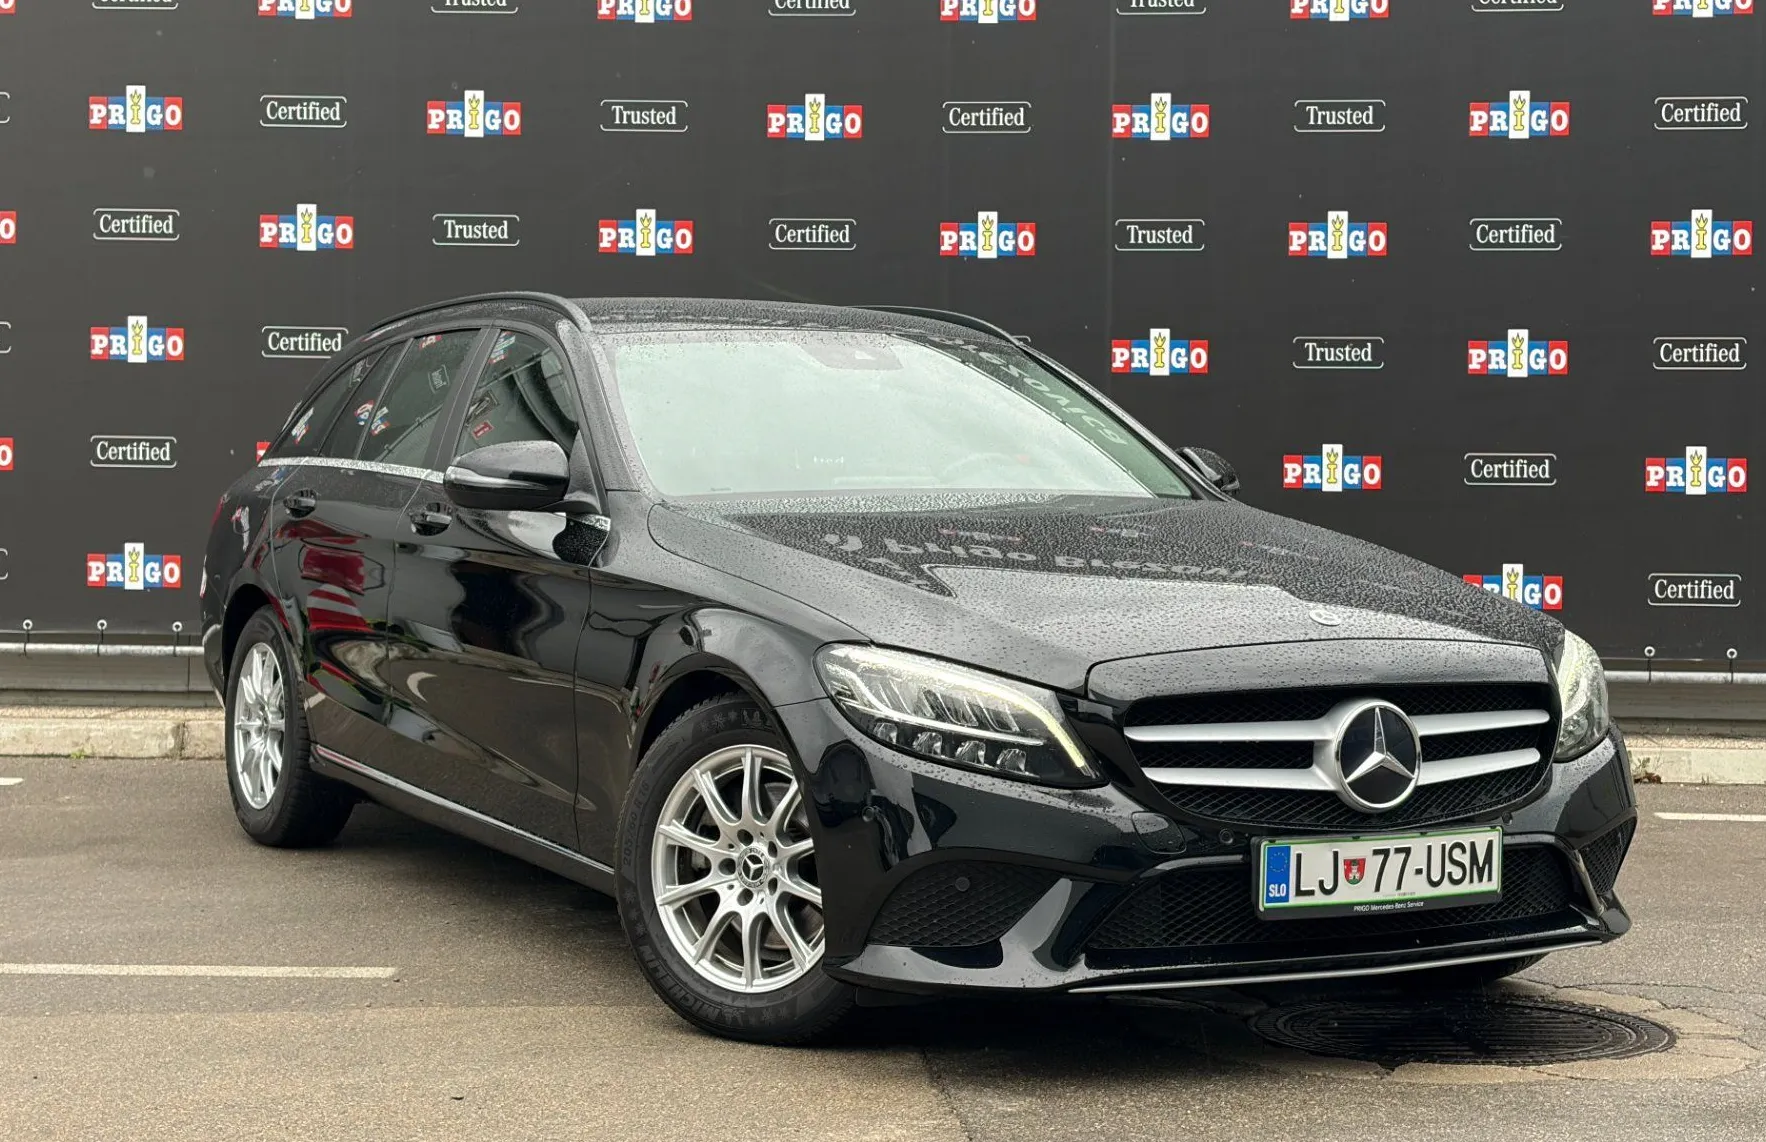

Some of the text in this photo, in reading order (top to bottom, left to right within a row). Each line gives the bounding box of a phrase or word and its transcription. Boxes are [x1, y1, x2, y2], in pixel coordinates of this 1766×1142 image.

[259, 0, 351, 12] PRIGO
[598, 0, 691, 16] PRIGO
[941, 0, 1035, 17] PRIGO
[1291, 0, 1388, 13] PRIGO
[90, 94, 181, 125] PRIGO
[266, 100, 341, 121] Certified
[428, 99, 520, 130] PRIGO
[611, 105, 677, 125] Trusted
[768, 103, 861, 134] PRIGO
[948, 106, 1025, 127] Certified
[1113, 103, 1208, 133] PRIGO
[1305, 105, 1374, 125] Trusted
[1470, 101, 1568, 131] PRIGO
[1661, 101, 1742, 123] Certified
[99, 213, 174, 234] Certified
[260, 214, 352, 244] PRIGO
[443, 219, 509, 240] Trusted
[600, 217, 692, 249] PRIGO
[774, 223, 851, 244] Certified
[1126, 224, 1194, 244] Trusted
[1475, 223, 1556, 244] Certified
[941, 220, 1034, 251] PRIGO
[1289, 221, 1385, 252] PRIGO
[1652, 219, 1750, 251] PRIGO
[91, 326, 183, 356] PRIGO
[267, 331, 342, 352] Certified
[1304, 342, 1373, 362] Trusted
[1112, 336, 1207, 369] PRIGO
[1469, 338, 1566, 370] PRIGO
[1659, 342, 1741, 363] Certified
[96, 440, 171, 462] Certified
[1284, 453, 1380, 484] PRIGO
[1470, 458, 1551, 479] Certified
[1647, 455, 1745, 487] PRIGO
[88, 552, 179, 583] PRIGO
[1463, 566, 1561, 605] IGO
[1654, 578, 1735, 600] Certified
[1295, 839, 1494, 897] LJ 77-USM
[1269, 884, 1287, 898] SLO
[1353, 904, 1370, 912] PRIGO
[639, 945, 721, 1020] MICHELIN
